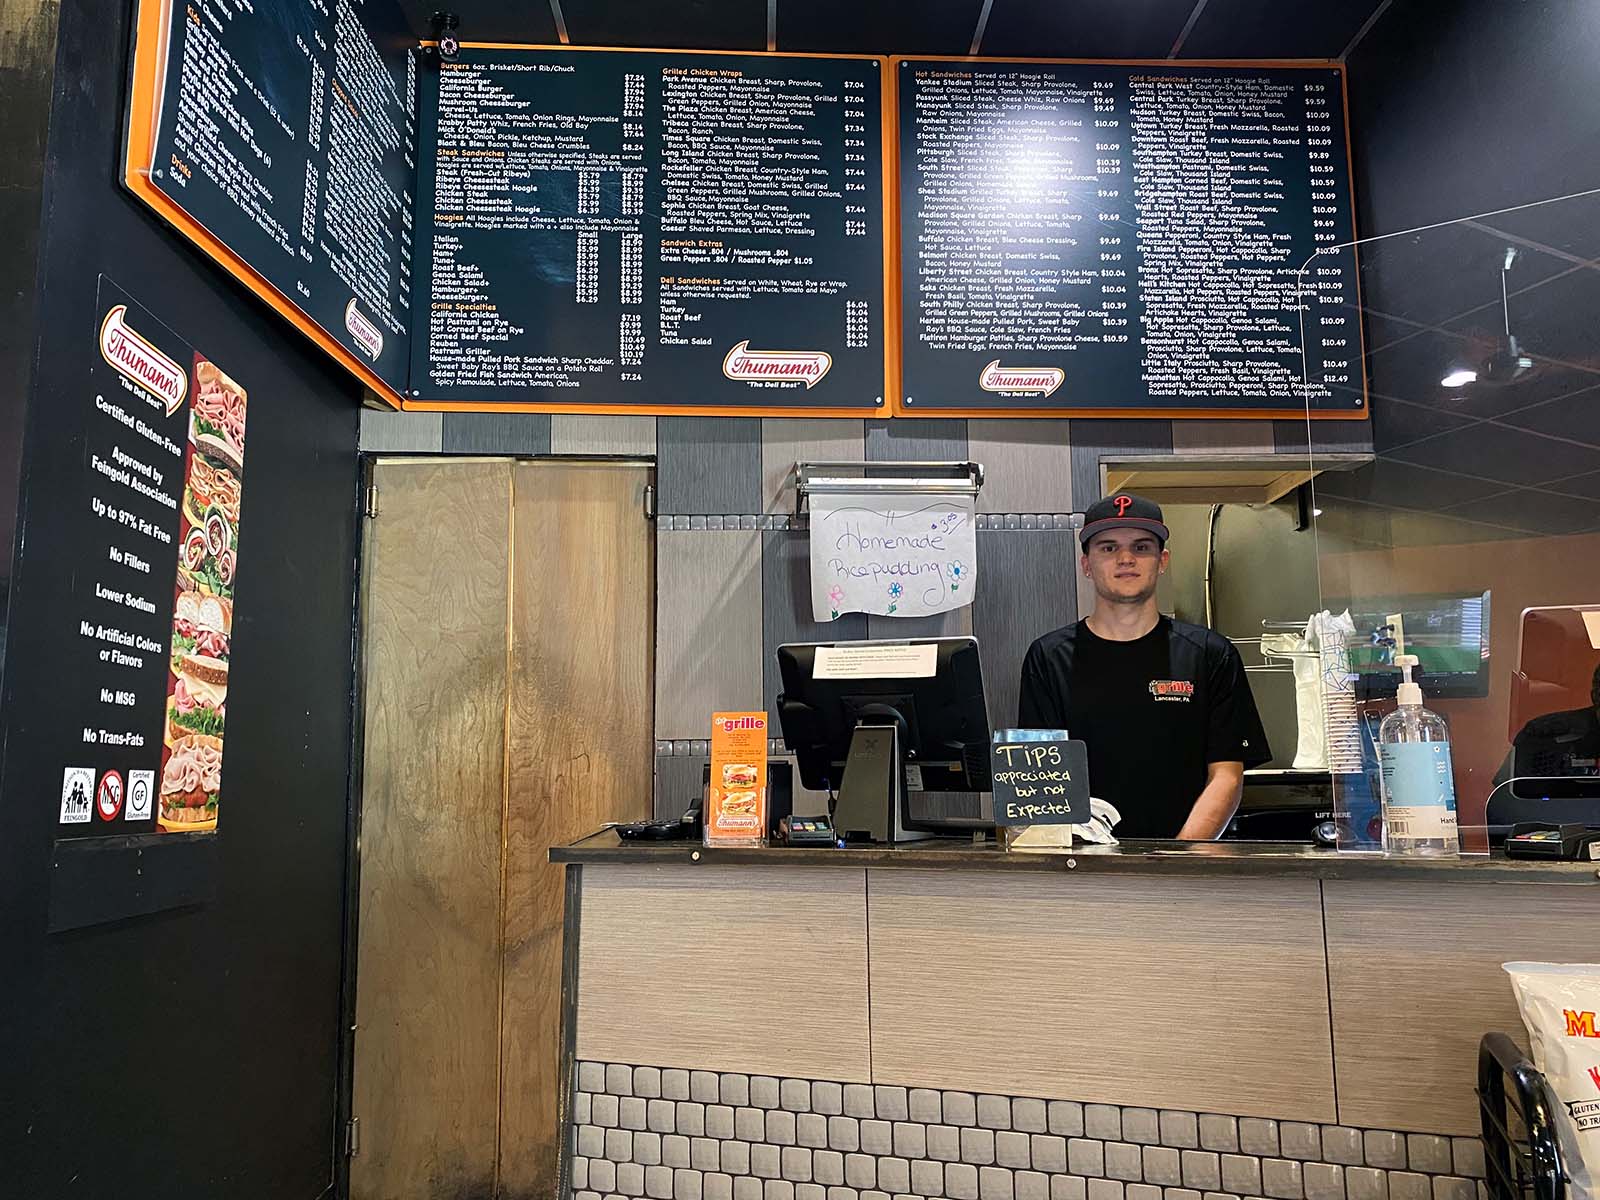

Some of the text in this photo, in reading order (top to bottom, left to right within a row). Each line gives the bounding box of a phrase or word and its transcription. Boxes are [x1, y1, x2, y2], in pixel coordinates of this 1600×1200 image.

[440, 63, 469, 71] Burgers
[490, 64, 537, 72] Brisket/Short
[624, 74, 644, 82] $7.24
[1095, 120, 1118, 128] $10.09
[1131, 123, 1157, 131] Uptown
[917, 149, 955, 157] Pittsburgh
[171, 154, 192, 178] Drinks
[169, 167, 186, 188] Soda
[622, 232, 643, 241] Large
[926, 260, 1001, 268] Bacon, Honey Mustard
[846, 301, 868, 309] $6.04
[1319, 296, 1343, 304] $10.89
[846, 340, 868, 348] $6.24
[950, 335, 987, 343] Hamburger
[1017, 335, 1038, 343] Sharp
[1040, 335, 1072, 343] Provolone
[1103, 335, 1128, 343] $10.59
[107, 328, 179, 399] Thumann's
[732, 356, 820, 375] Thumann's
[1164, 360, 1182, 368] Italy
[987, 371, 1055, 387] Thumann's
[133, 385, 147, 401] Deli
[95, 395, 182, 457] Certified Gluten-Free
[112, 445, 163, 486] Approved by
[92, 455, 177, 510] Feingold Association
[1113, 495, 1133, 517] P
[92, 497, 171, 544] Up to 97% Fat Free
[836, 522, 946, 553] Homemade
[109, 546, 150, 573] No Fillers
[95, 583, 156, 615] Lower Sodium
[80, 621, 162, 654] No Artificial Colors
[99, 650, 143, 669] or Flavors
[100, 688, 136, 706] No MSG
[725, 718, 764, 731] grille
[83, 728, 144, 747] No Trans-Fats
[994, 770, 1071, 785] appreciated
[135, 790, 144, 800] GF
[1016, 784, 1066, 797] but not
[1007, 799, 1071, 819] Expected
